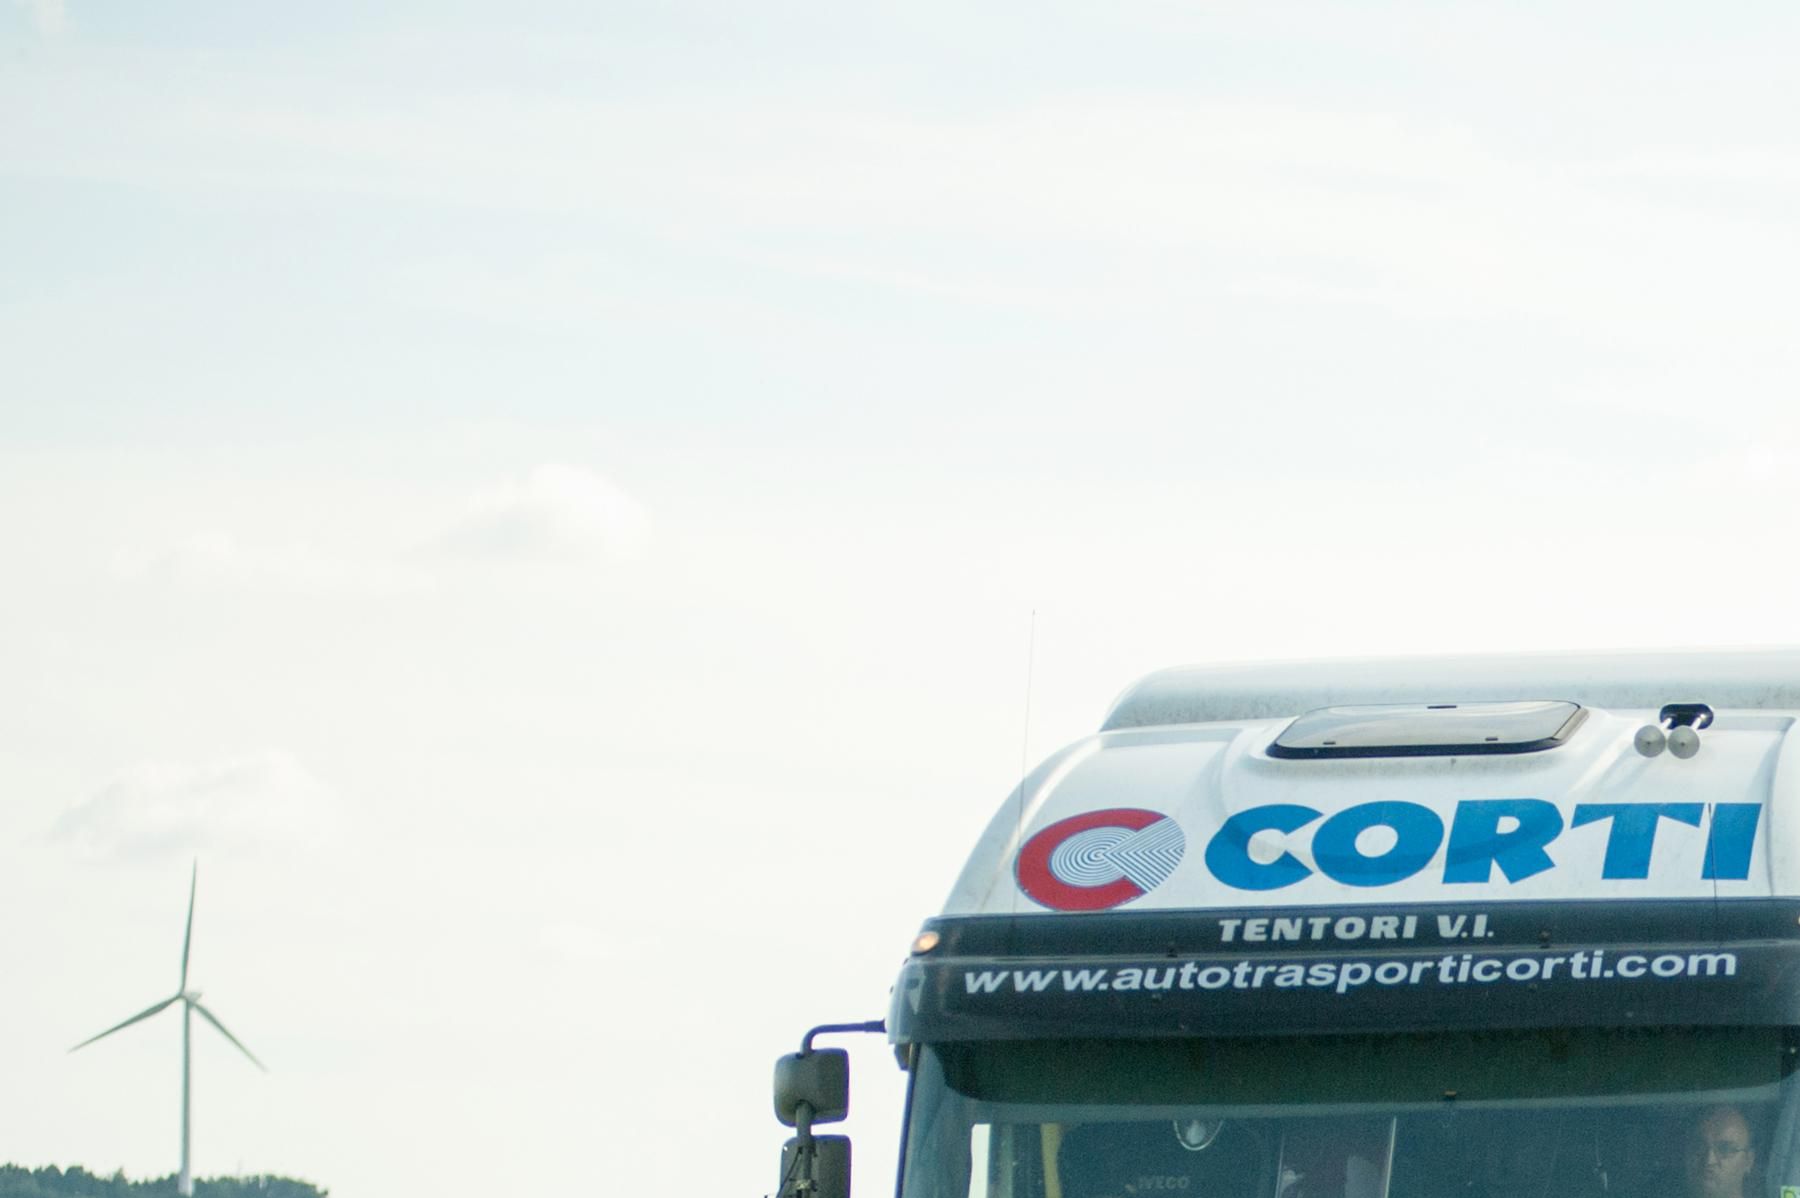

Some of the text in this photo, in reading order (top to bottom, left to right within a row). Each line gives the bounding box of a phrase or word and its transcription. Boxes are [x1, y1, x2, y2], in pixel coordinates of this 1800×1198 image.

[1204, 798, 1763, 891] CORTI
[1218, 913, 1494, 942] TENTORI V.I.
[963, 949, 1737, 994] www.autotrasporticorti.com
